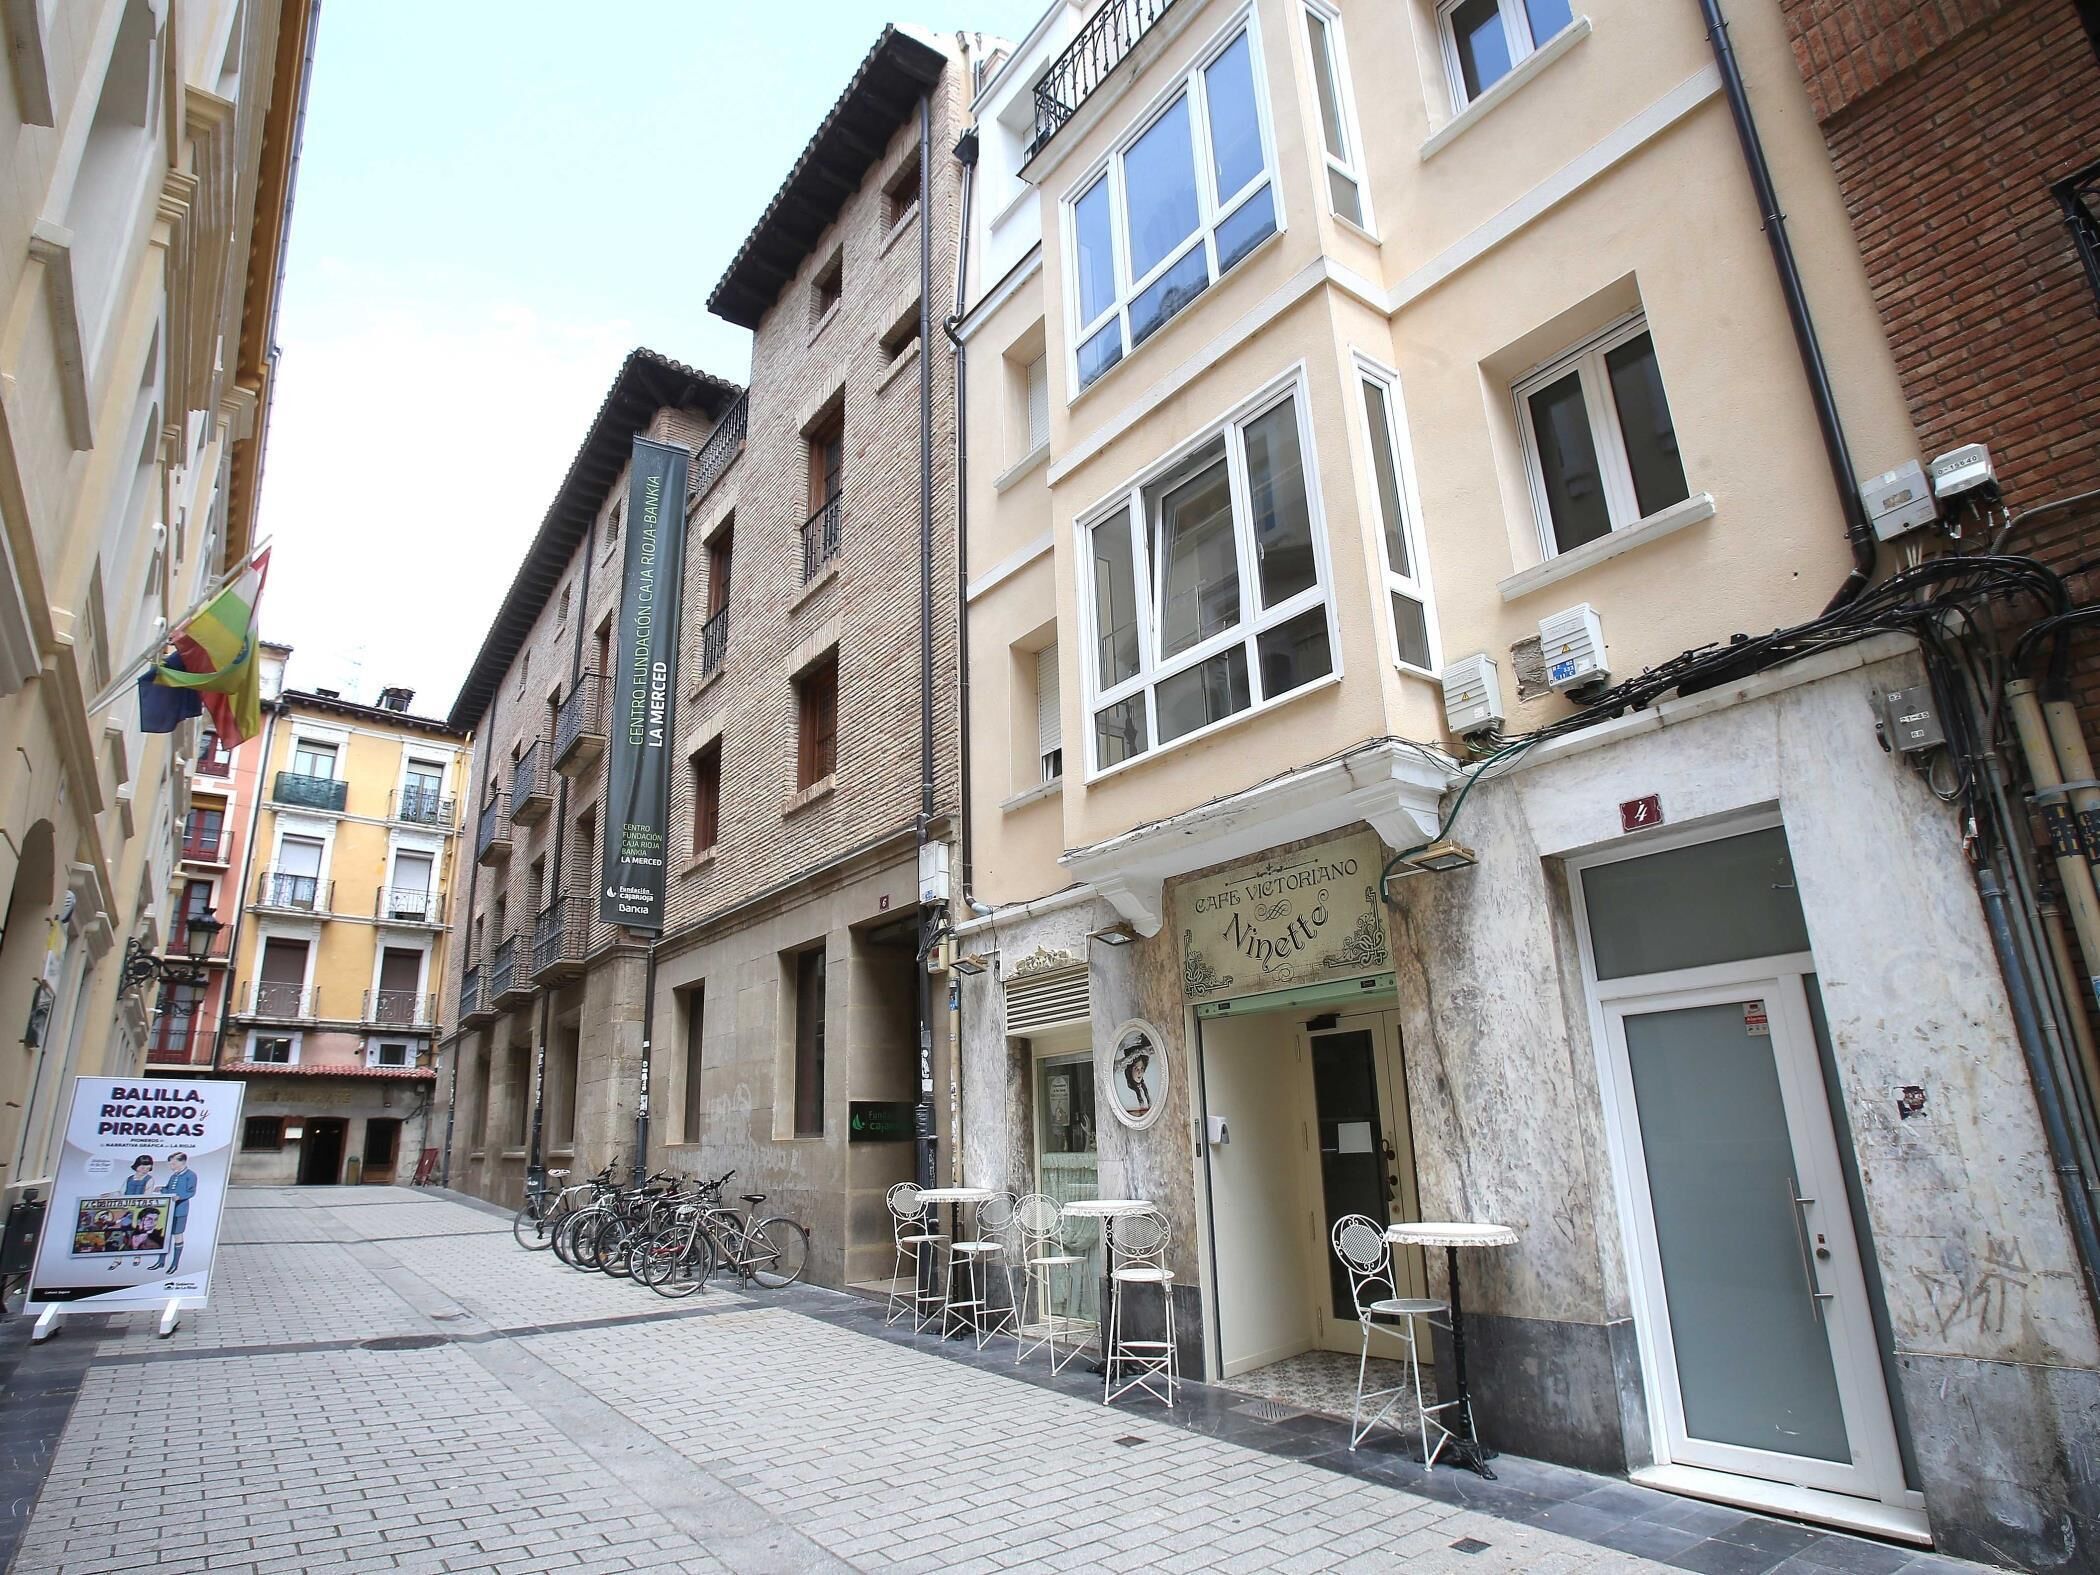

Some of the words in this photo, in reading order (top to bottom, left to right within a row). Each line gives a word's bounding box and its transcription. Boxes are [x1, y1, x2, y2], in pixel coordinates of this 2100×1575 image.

[641, 476, 660, 565] RIOJA-BANKIA
[638, 569, 654, 604] CAJA
[633, 606, 652, 685] FUNDACIÓN
[650, 661, 667, 724] MERCED
[629, 689, 646, 745] CENTRO
[649, 728, 663, 748] LA
[1634, 801, 1648, 821] 4
[622, 831, 662, 841] FUNDACIÓN
[623, 823, 650, 832] CENTRO
[621, 848, 647, 856] BANKIA
[622, 840, 639, 848] CAJA
[640, 841, 660, 849] RIOJA
[632, 857, 662, 866] MERCED
[1245, 858, 1358, 901] VICTORIANO
[619, 886, 650, 894] Fundación
[618, 904, 649, 914] Bankia
[881, 898, 888, 908] 6
[111, 1087, 205, 1104] BALILLA,
[100, 1104, 197, 1119] RICARDO
[199, 1109, 209, 1121] y
[98, 1122, 204, 1136] PIRRACAS
